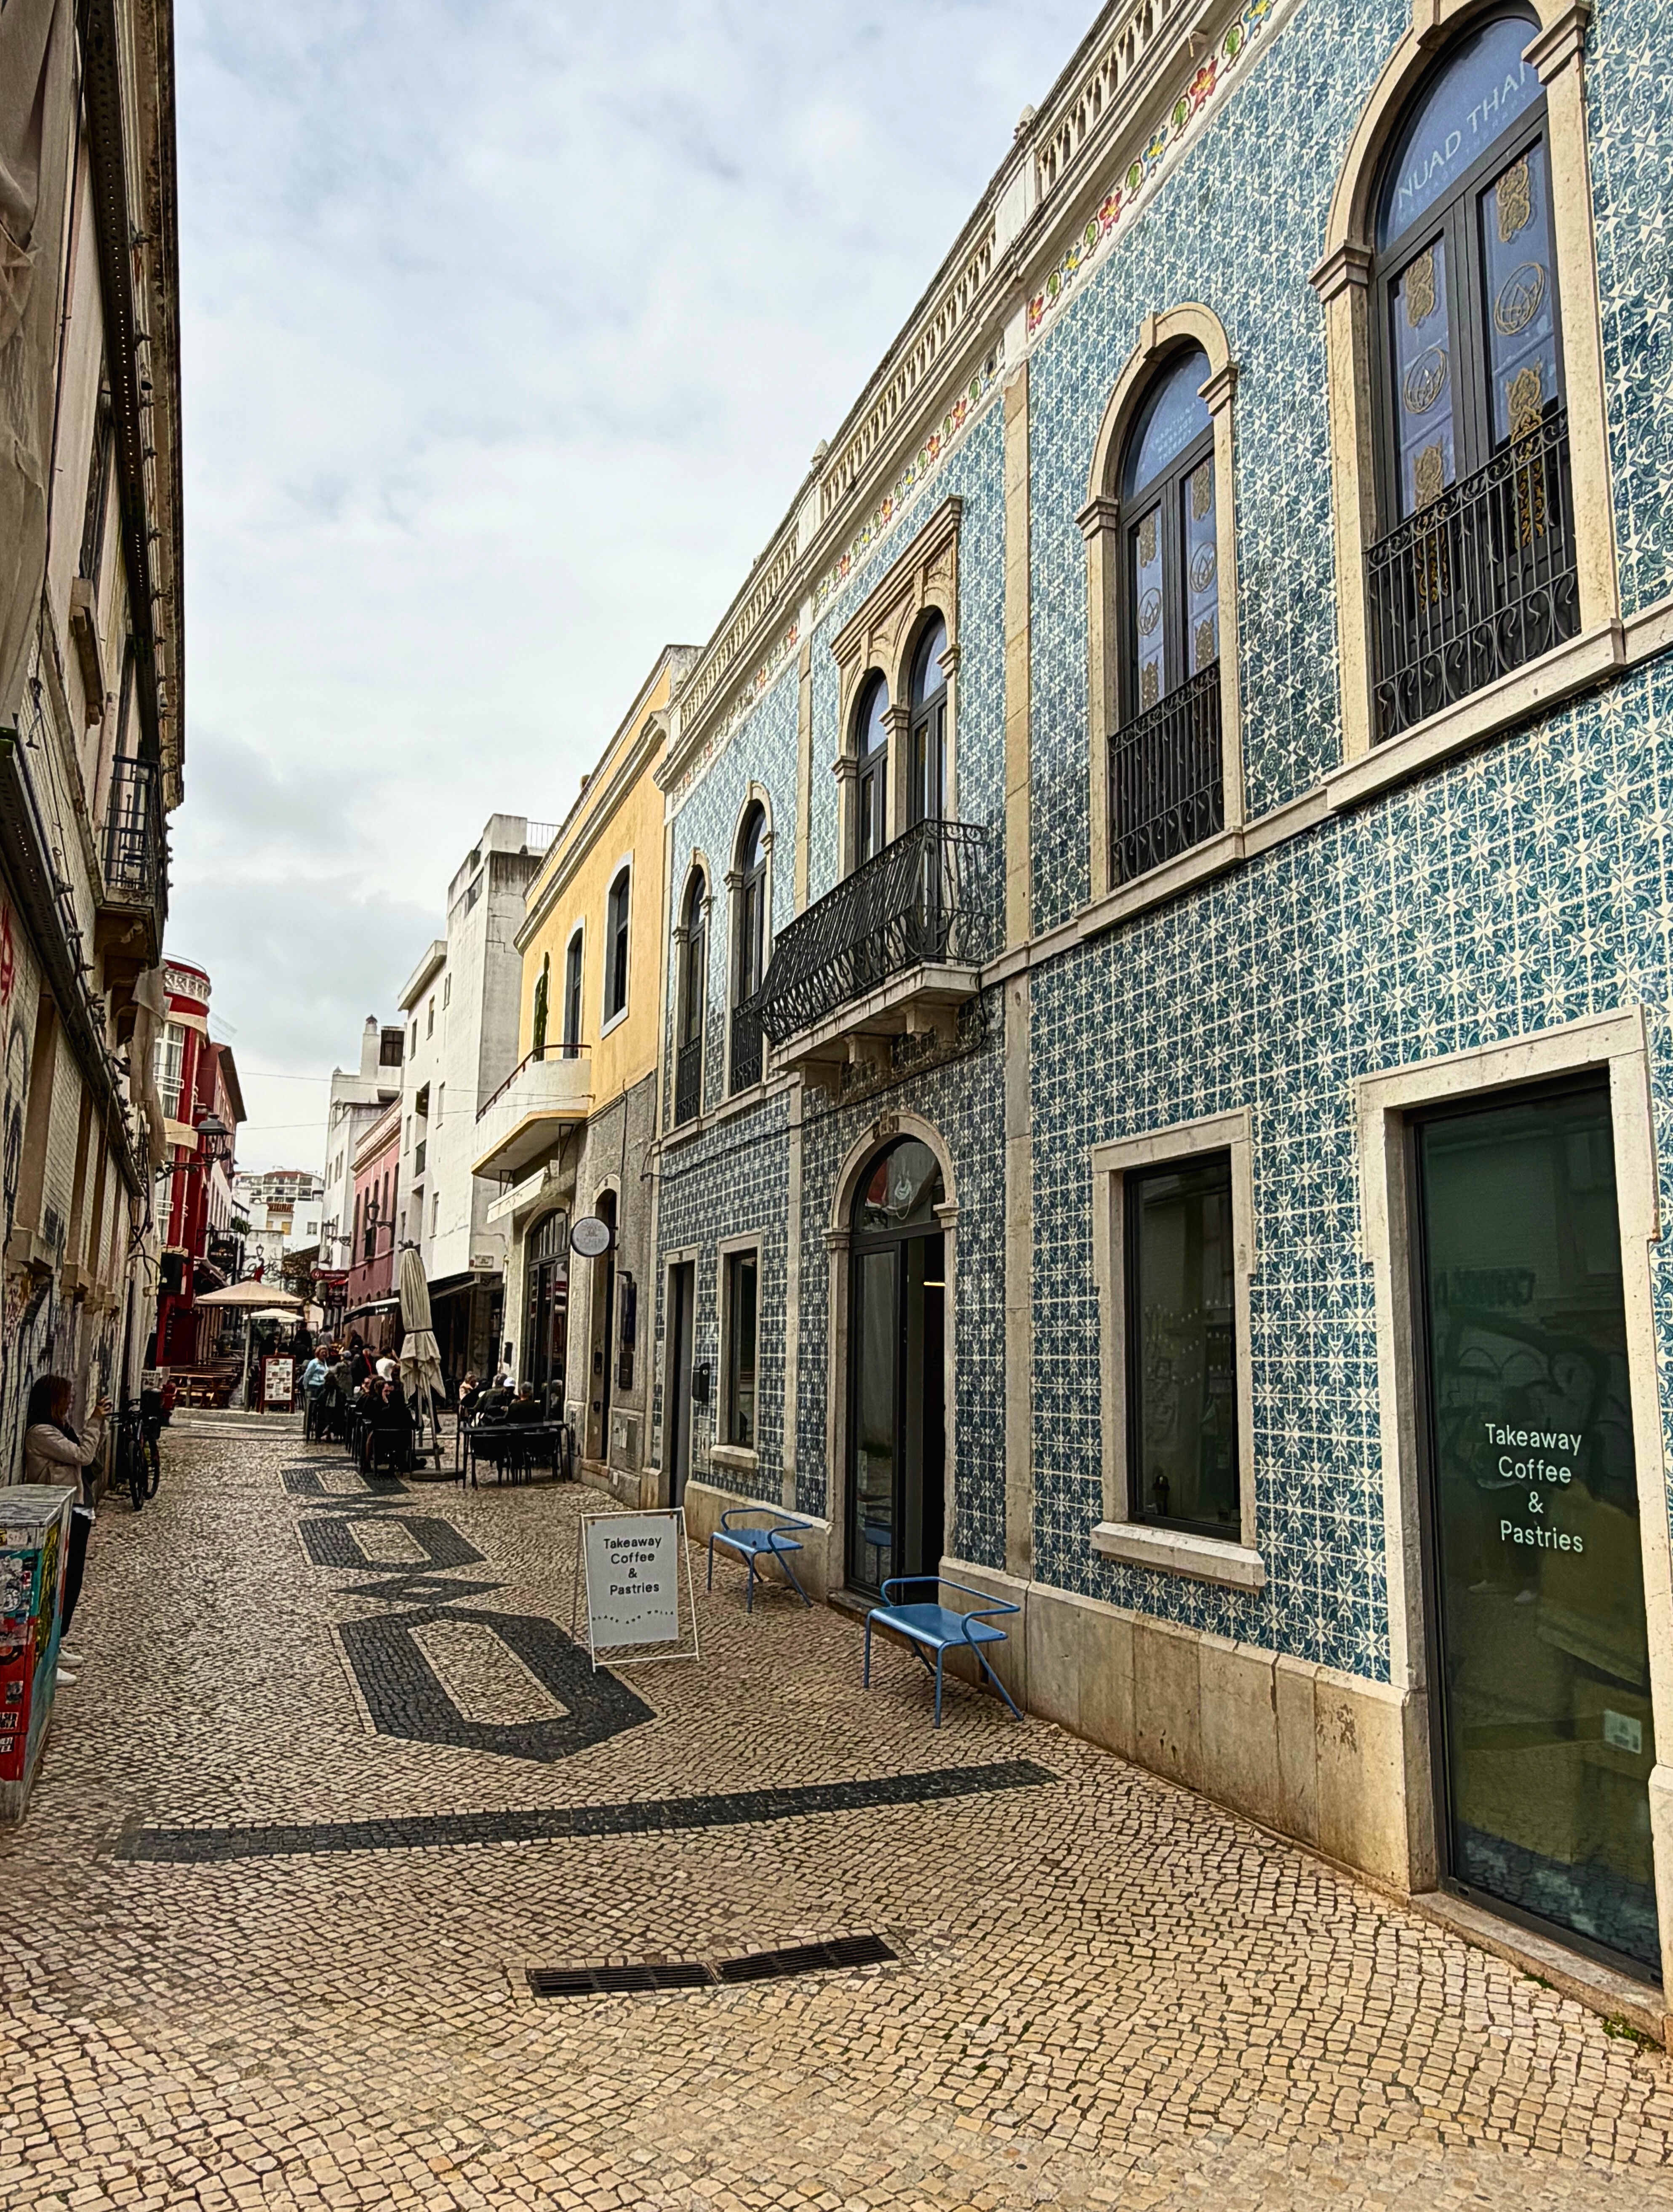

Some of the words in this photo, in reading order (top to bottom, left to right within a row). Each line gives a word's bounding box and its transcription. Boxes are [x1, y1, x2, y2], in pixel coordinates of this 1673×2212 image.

[1397, 130, 1461, 209] NUAD
[1466, 61, 1525, 133] THAI
[1485, 1423, 1582, 1456] Takeaway
[1498, 1456, 1572, 1484] Coffee
[1528, 1491, 1544, 1514] &
[603, 1537, 662, 1549] Takeaway
[1500, 1520, 1583, 1553] Pastries
[611, 1551, 655, 1564] Coffee
[628, 1568, 637, 1578] &
[610, 1582, 659, 1595] Pastries
